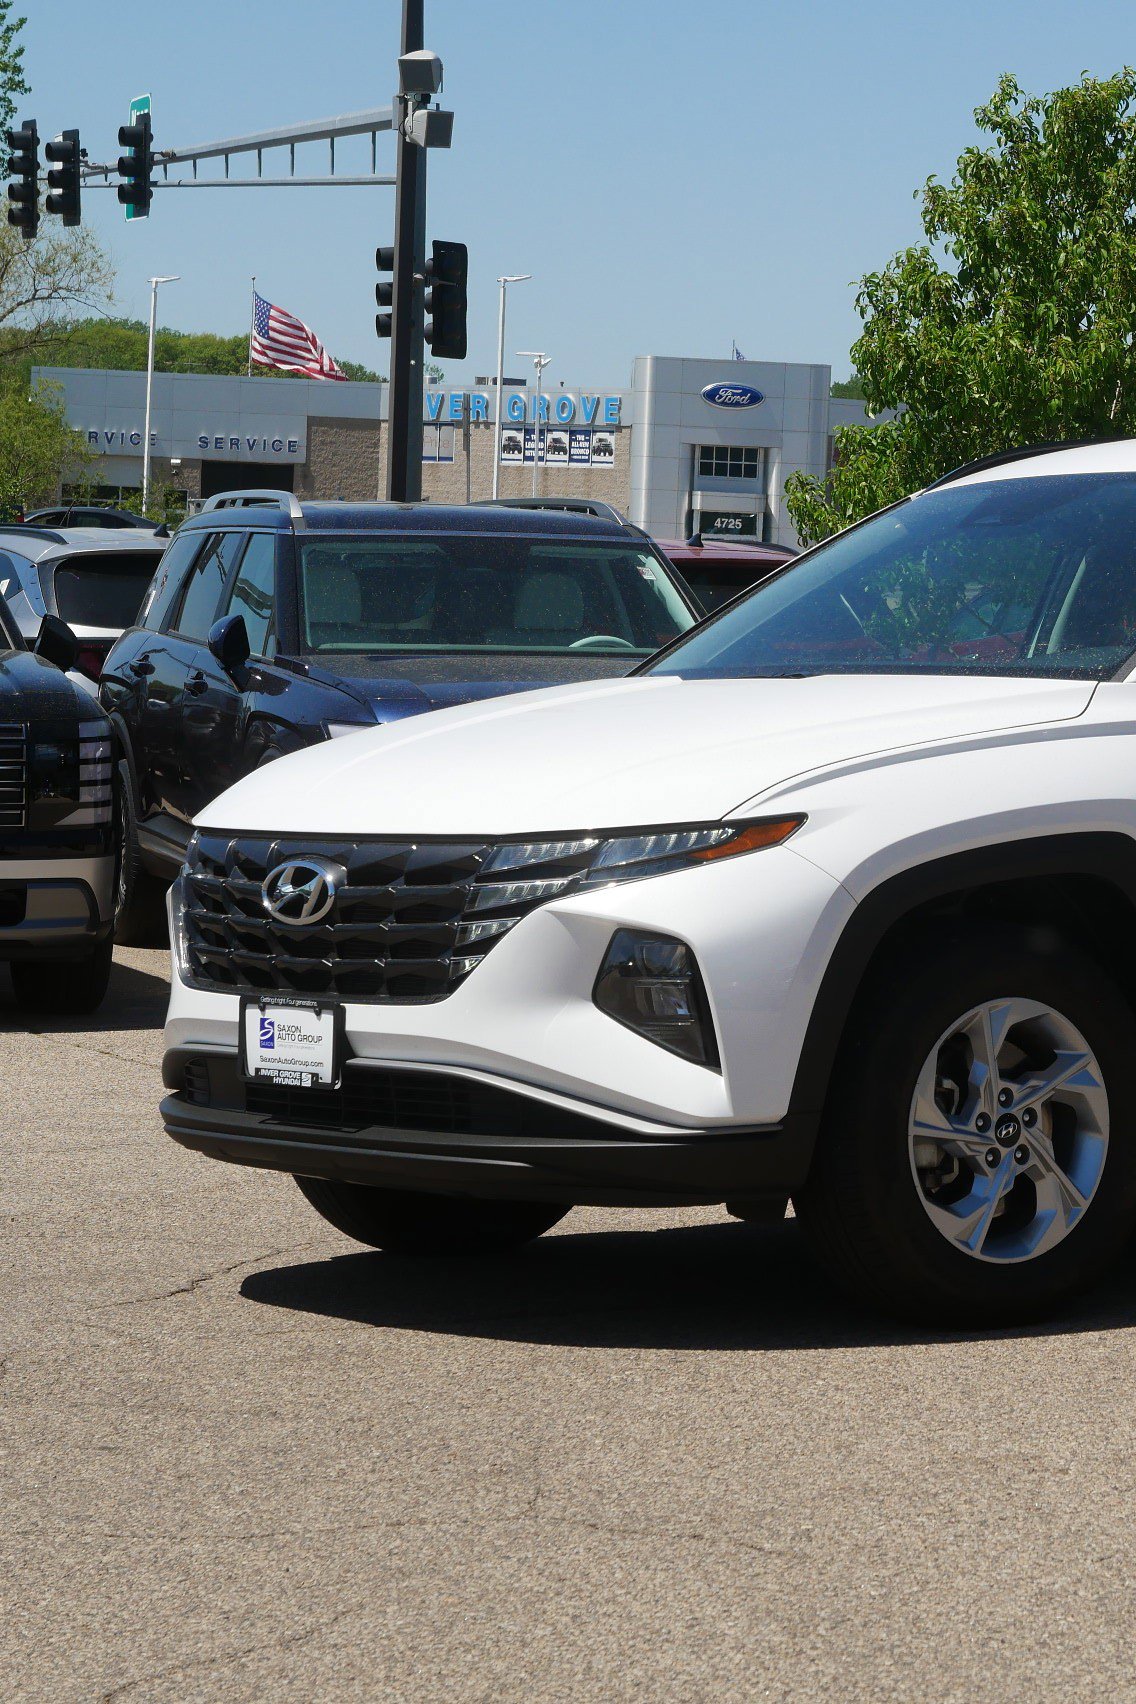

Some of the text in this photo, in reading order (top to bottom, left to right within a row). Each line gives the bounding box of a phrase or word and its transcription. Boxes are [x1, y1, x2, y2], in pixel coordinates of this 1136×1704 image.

[714, 388, 751, 404] Ford
[426, 392, 620, 424] VER GROVE
[88, 431, 156, 446] RVICE
[198, 436, 298, 453] SERVICE
[714, 517, 742, 529] 4725
[277, 1024, 302, 1033] SAXON
[277, 1033, 323, 1044] AUTO GROUP
[259, 1055, 324, 1068] SaxonAutoGroup.com
[260, 1068, 301, 1079] INVER GROVE
[272, 1076, 301, 1086] HYUNDAI
